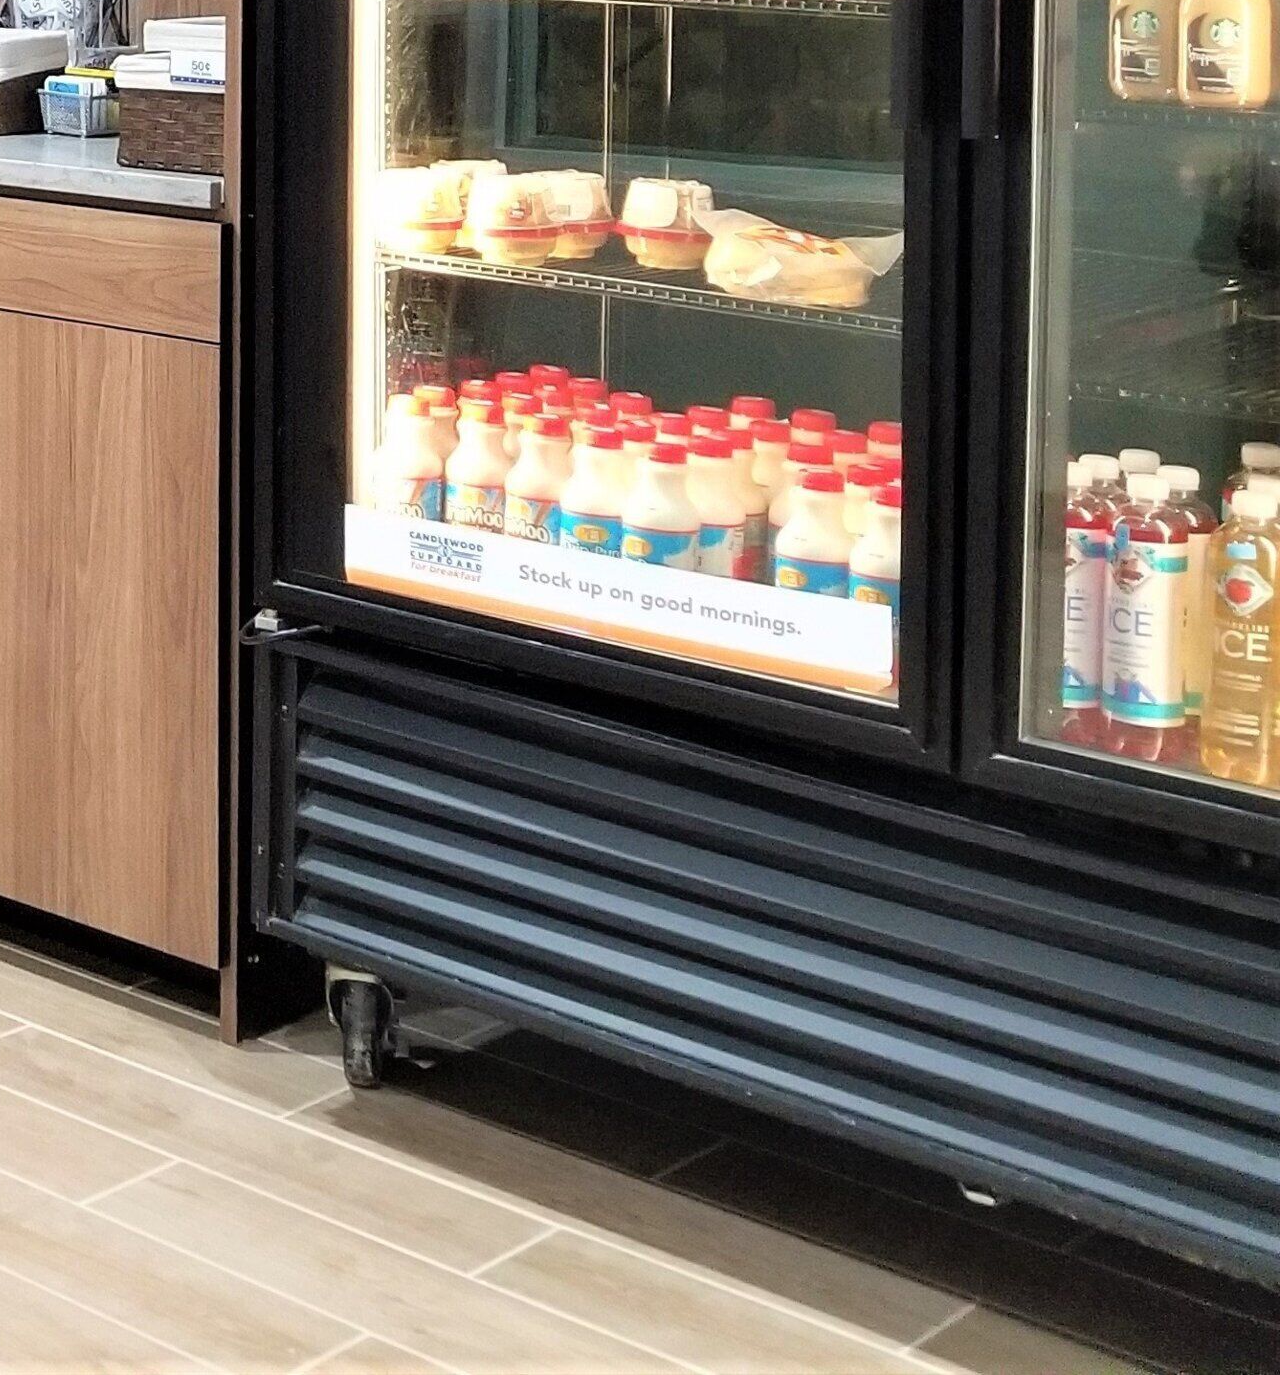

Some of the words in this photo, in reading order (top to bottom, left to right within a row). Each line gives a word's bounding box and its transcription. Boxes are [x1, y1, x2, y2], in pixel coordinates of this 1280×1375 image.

[191, 60, 211, 71] 50¢
[409, 530, 484, 553] CANDLEWOOD
[410, 550, 482, 572] CUPBOARD
[429, 564, 481, 583] breakfast
[519, 565, 571, 590] Stock
[579, 575, 603, 599] up
[610, 583, 634, 603] on
[641, 589, 693, 614] good
[700, 604, 802, 636] mornings.
